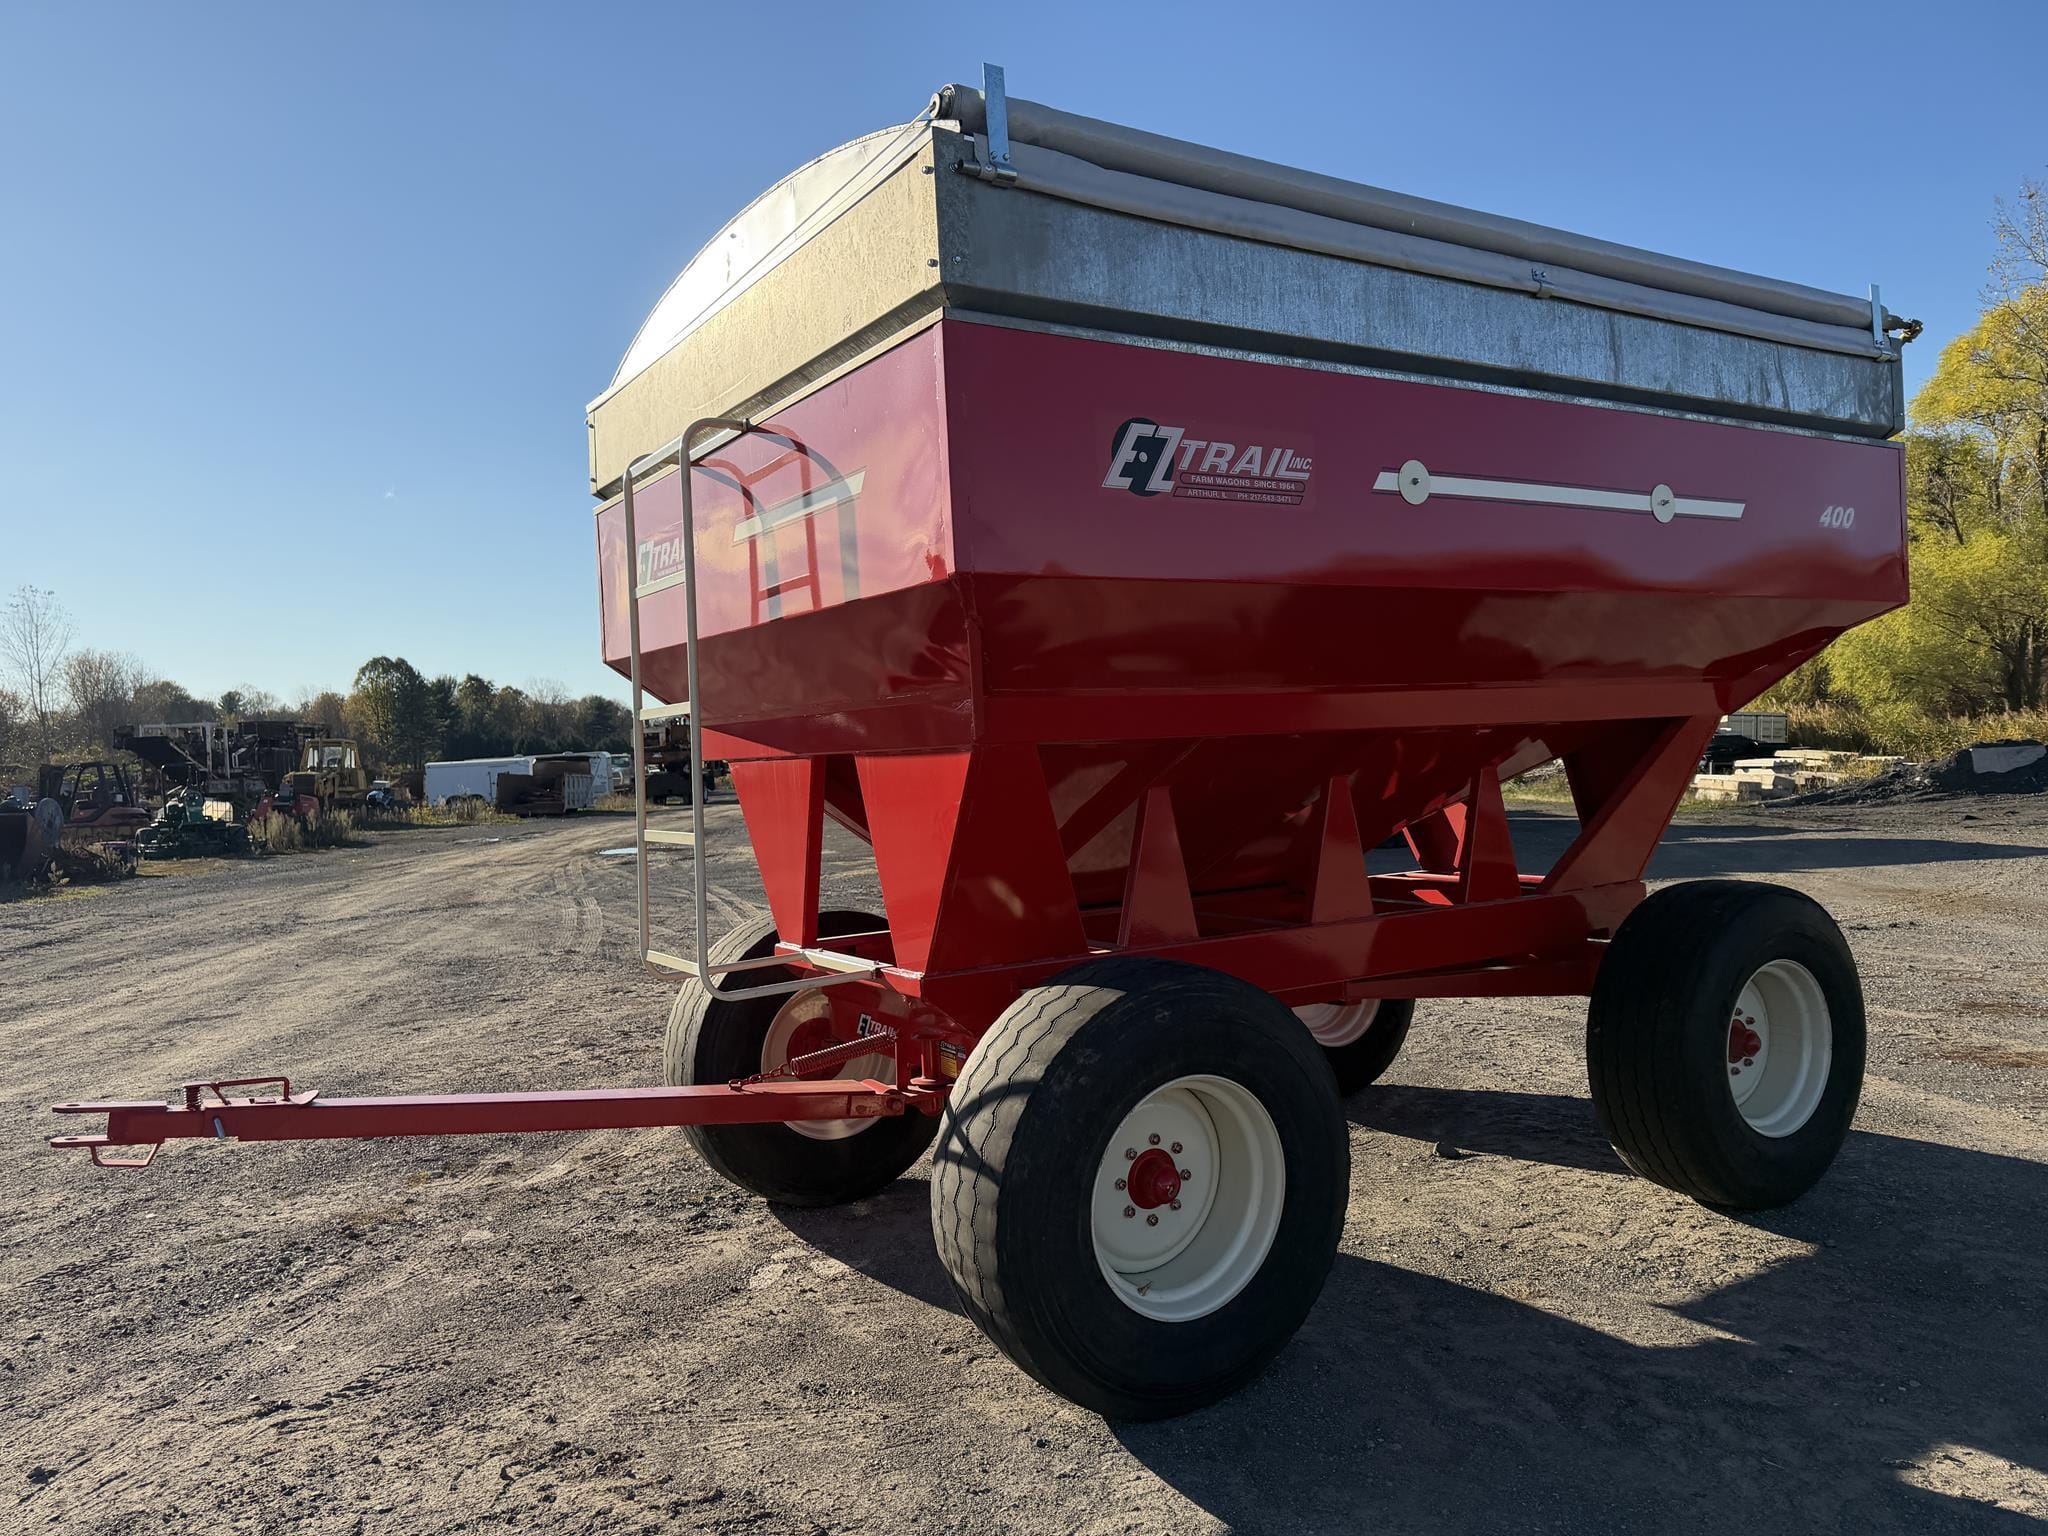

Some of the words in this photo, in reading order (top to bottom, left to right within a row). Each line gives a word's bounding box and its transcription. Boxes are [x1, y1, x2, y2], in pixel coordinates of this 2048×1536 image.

[1178, 439, 1311, 480] TRAIL
[1191, 475, 1214, 485] FARM
[1215, 476, 1250, 487] WAGONS
[1254, 480, 1277, 489] SINCE
[1279, 481, 1295, 490] 1964
[1819, 505, 1855, 529] 400
